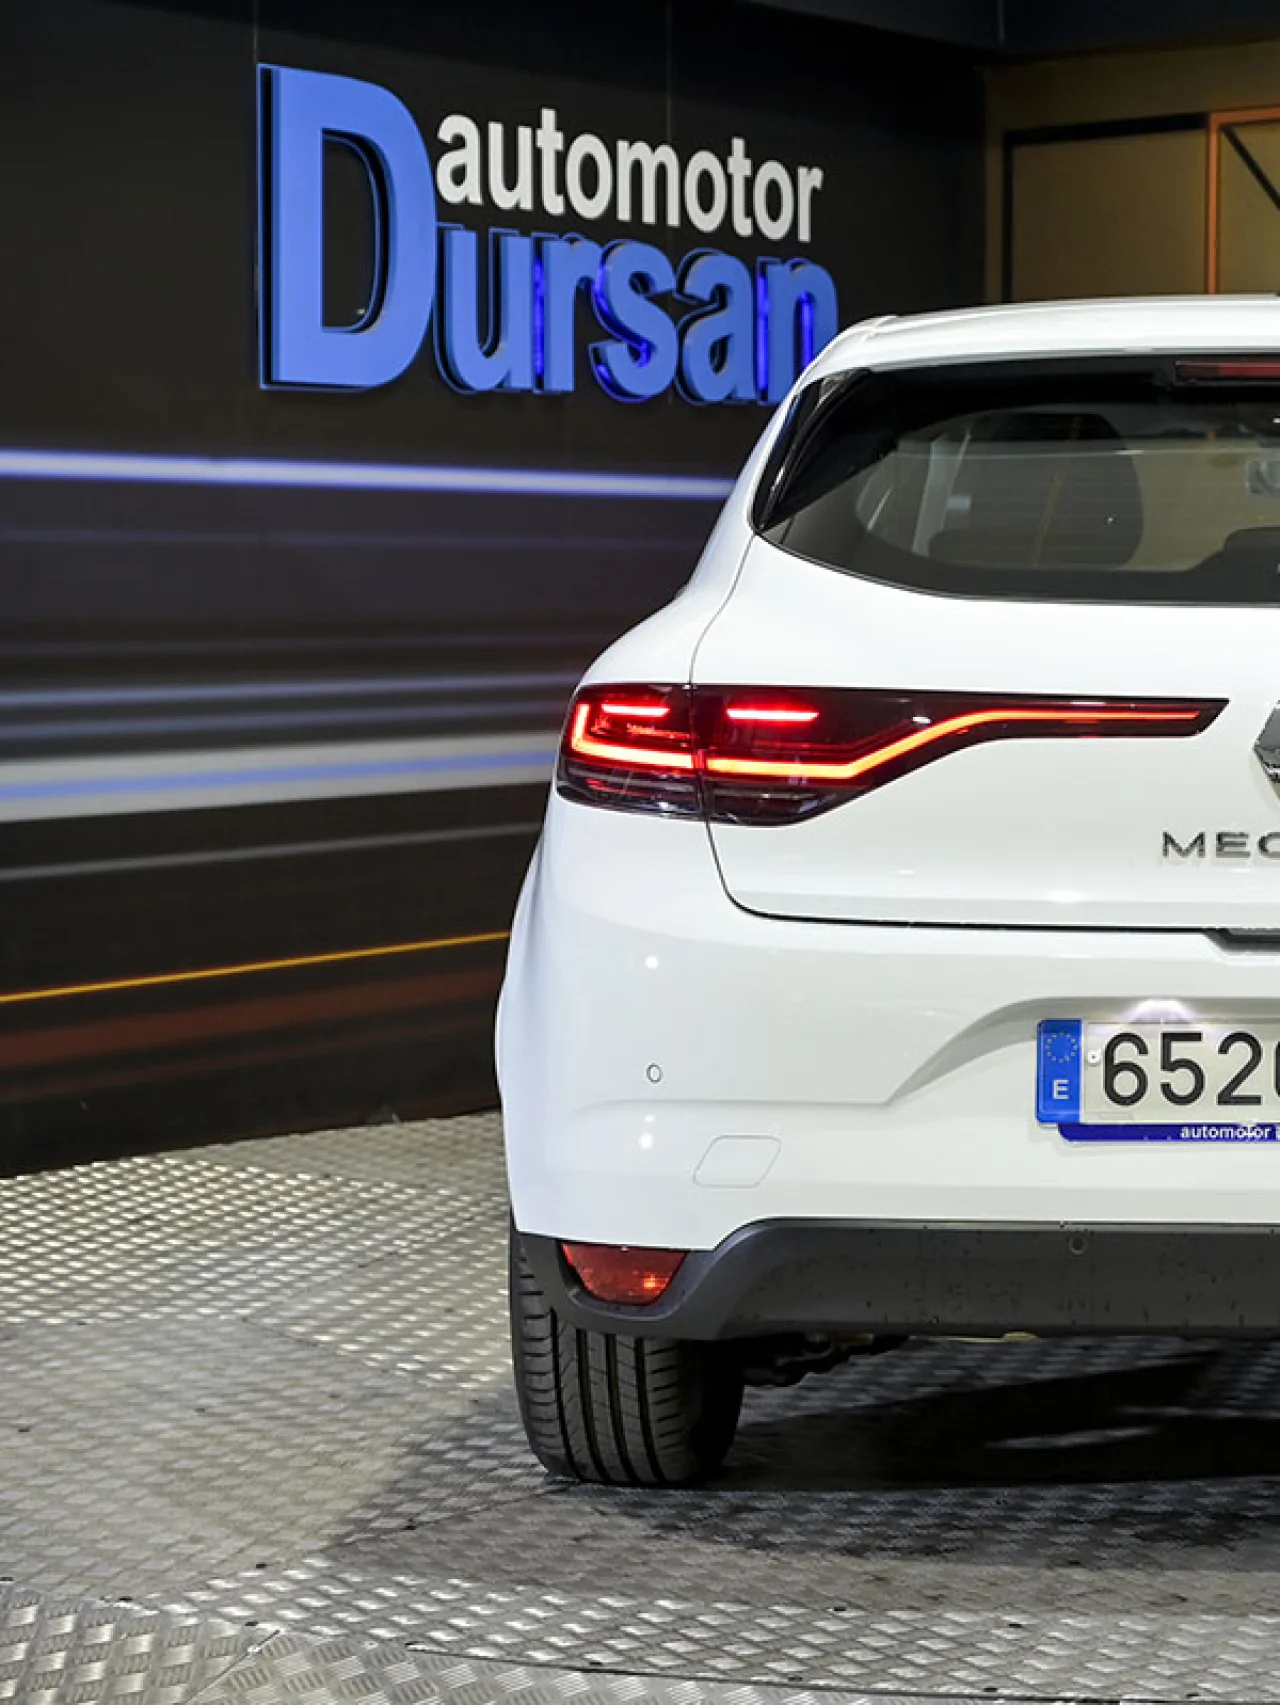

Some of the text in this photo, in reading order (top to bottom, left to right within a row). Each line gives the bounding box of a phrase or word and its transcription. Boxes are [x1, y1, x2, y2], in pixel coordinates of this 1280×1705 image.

[436, 107, 823, 242] automotor
[257, 62, 839, 406] Dursan
[1053, 1079, 1069, 1100] E
[1180, 1125, 1272, 1141] automotor
